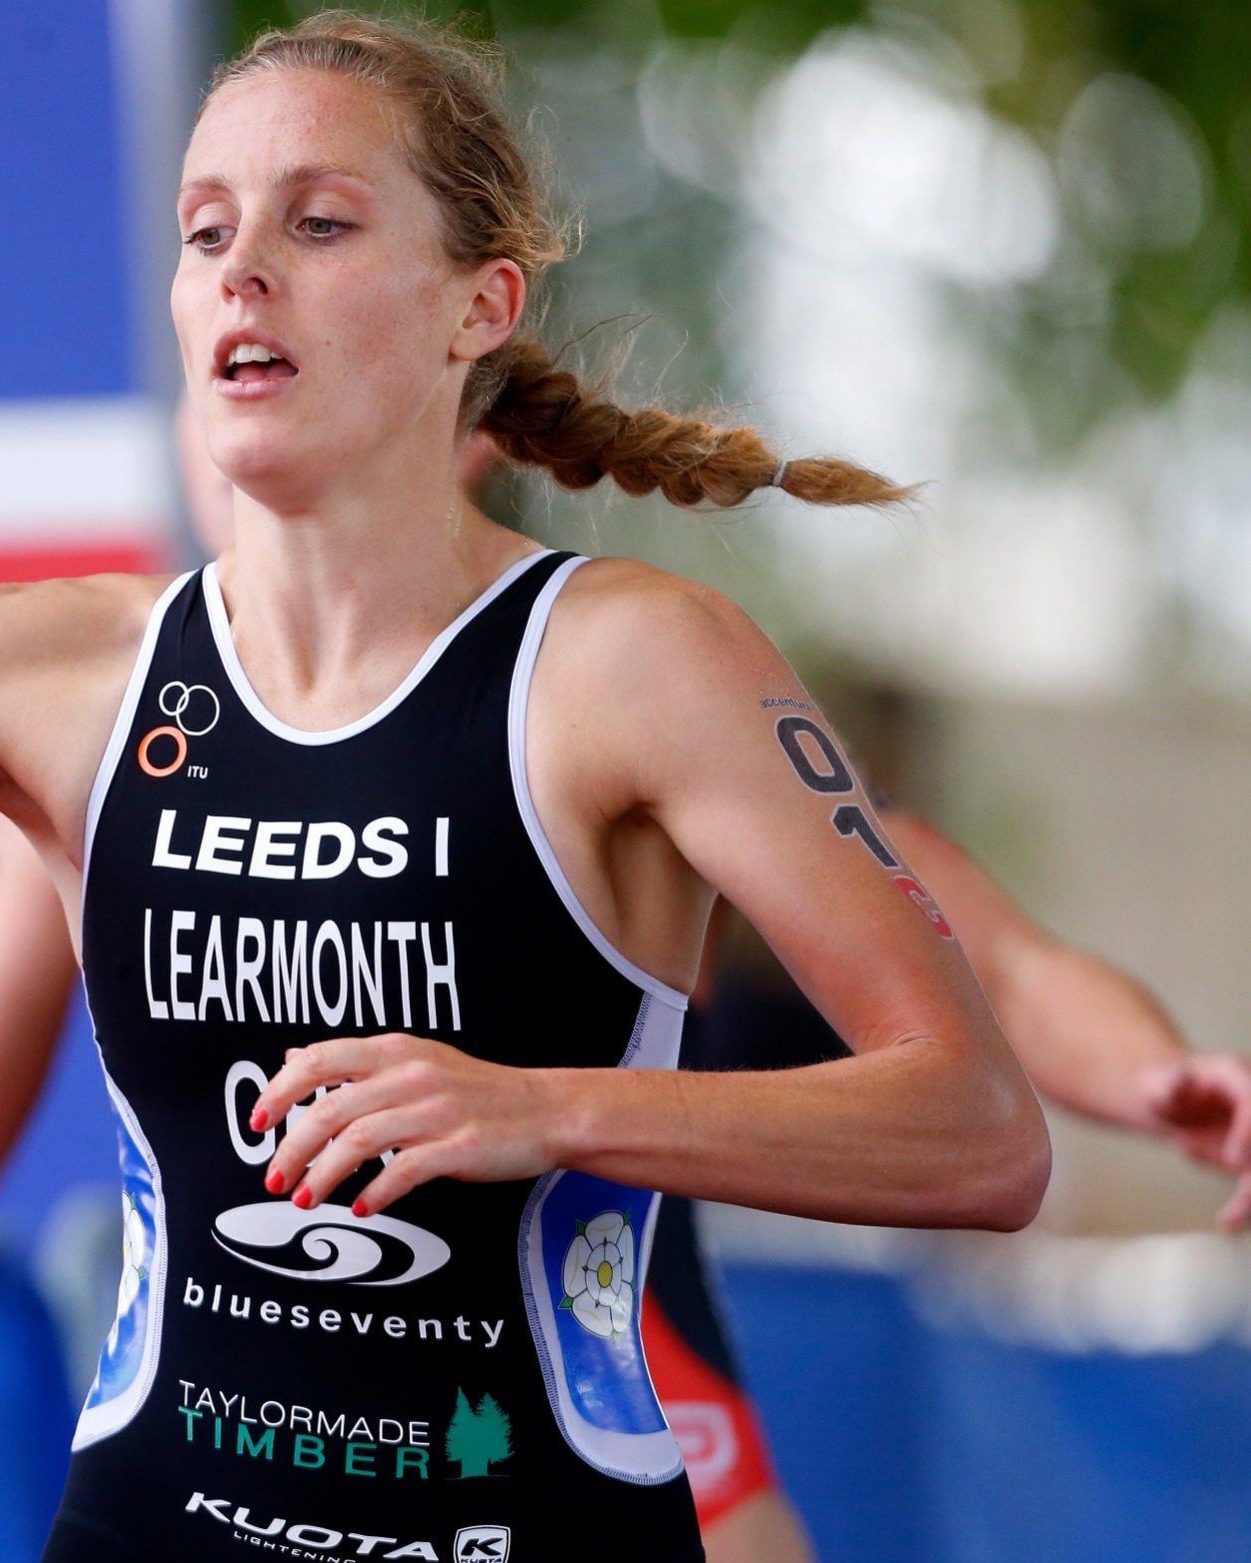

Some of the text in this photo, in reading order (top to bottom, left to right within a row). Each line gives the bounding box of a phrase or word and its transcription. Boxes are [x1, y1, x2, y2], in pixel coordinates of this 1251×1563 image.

[187, 765, 209, 780] ITU
[151, 808, 410, 881] LEEDS
[143, 908, 462, 1032] LEARMONTH
[182, 1277, 505, 1349] blueseventy
[178, 1379, 431, 1446] TAYLORMADE
[178, 1405, 430, 1480] TIMBER
[184, 1491, 440, 1562] KUOTA
